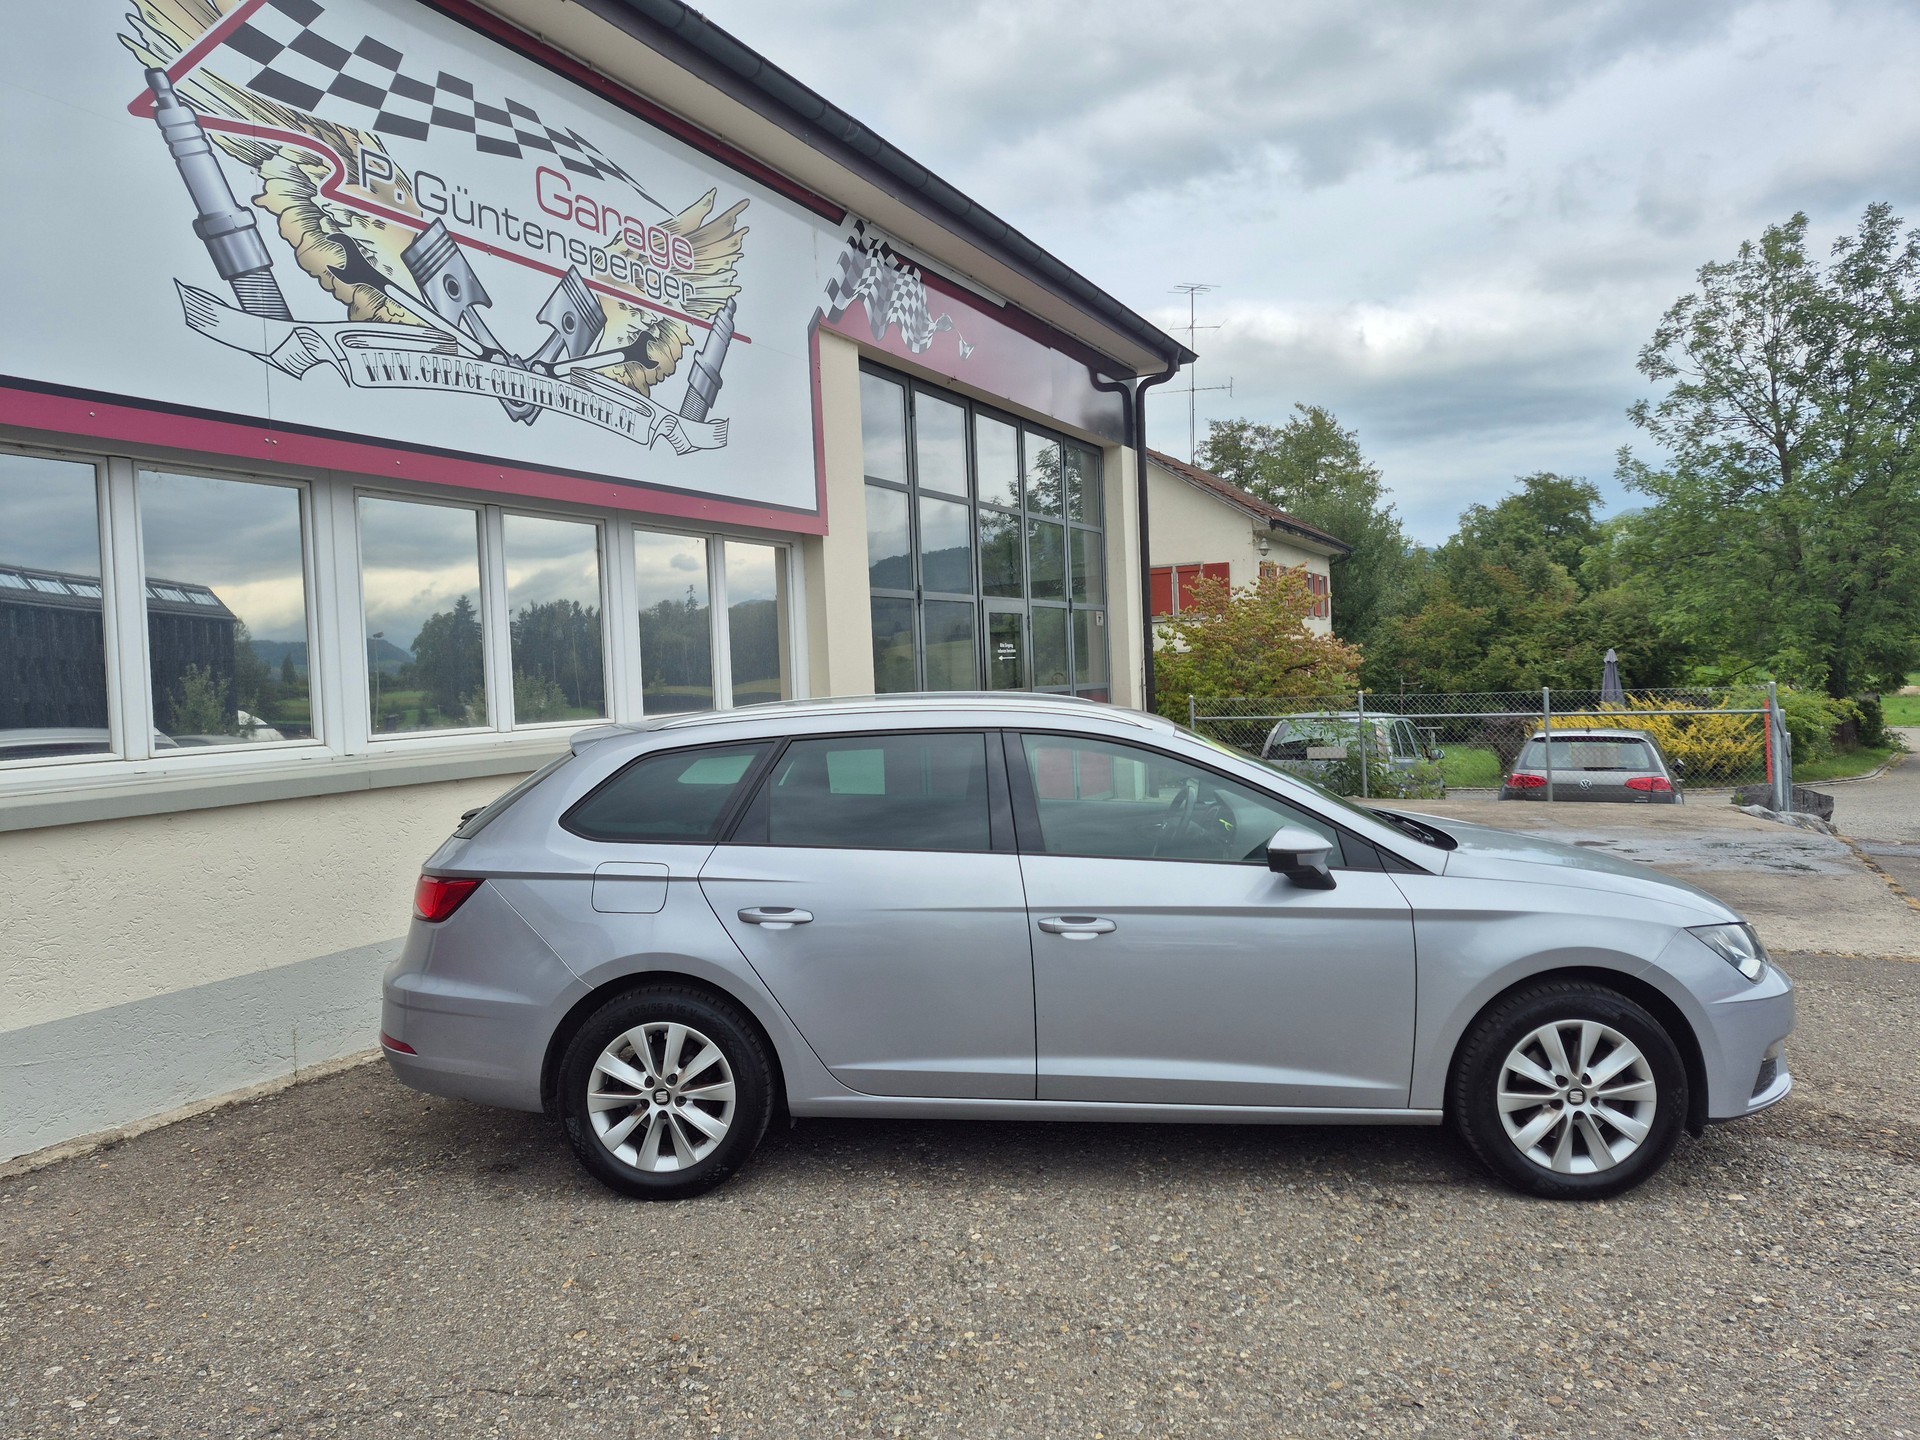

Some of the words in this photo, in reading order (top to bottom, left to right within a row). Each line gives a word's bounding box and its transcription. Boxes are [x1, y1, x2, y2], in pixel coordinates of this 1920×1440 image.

[360, 148, 403, 201] P.
[414, 170, 695, 302] Güntensperger
[535, 166, 694, 270] Garage
[361, 352, 637, 436] WWW.GARAGE-GUENTENSPERGER.CH
